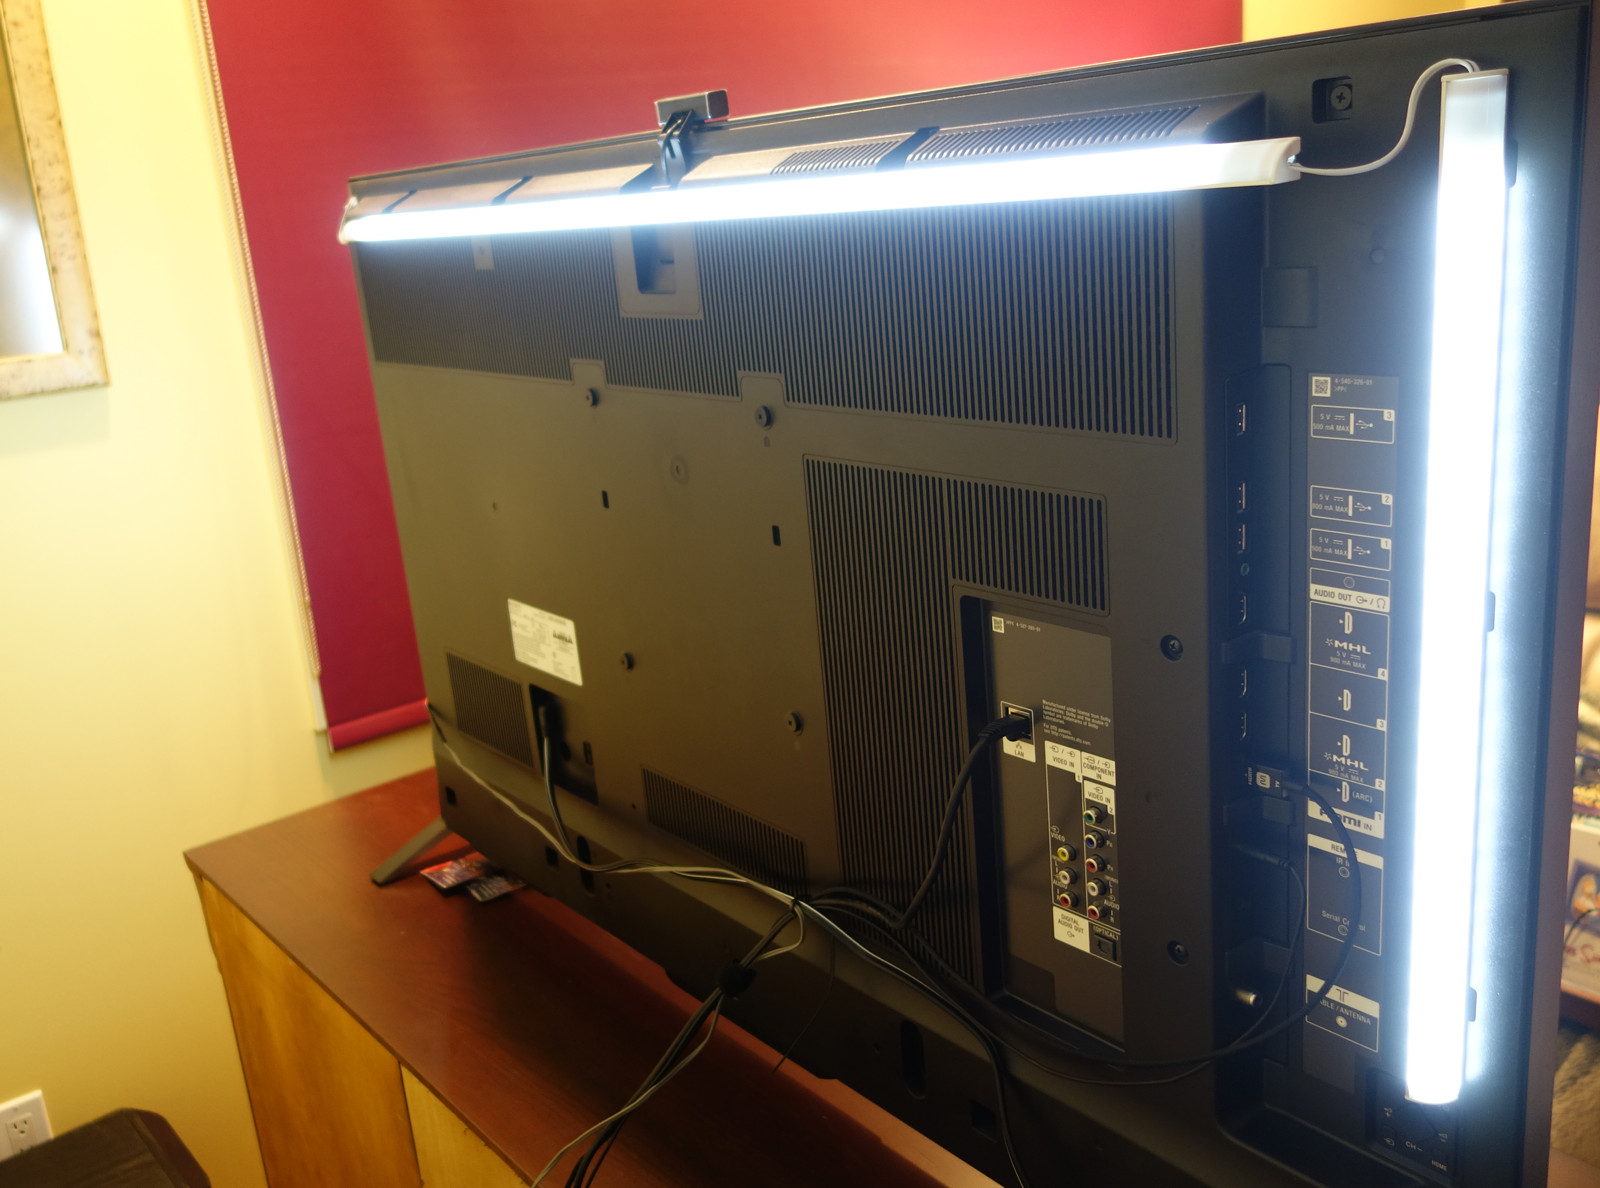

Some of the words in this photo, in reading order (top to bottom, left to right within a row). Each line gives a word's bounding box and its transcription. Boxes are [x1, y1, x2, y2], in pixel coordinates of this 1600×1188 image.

[1386, 411, 1392, 419] 3
[1335, 424, 1350, 432] MAX
[1384, 495, 1390, 503] 2
[1335, 505, 1348, 513] MAX
[1334, 548, 1348, 556] MAX
[1313, 588, 1335, 598] AUDIO
[1337, 592, 1352, 601] OUT
[1334, 639, 1372, 655] MHL
[1352, 661, 1367, 669] MAX
[1379, 720, 1384, 728] 3
[1014, 749, 1025, 758] LAN
[1052, 755, 1068, 766] VIDEO
[1332, 754, 1369, 771] MHL
[1082, 762, 1115, 777] COMPONENT
[1350, 774, 1364, 783] MAX
[1377, 780, 1383, 788] 2
[1087, 791, 1104, 802] VIDEO
[1352, 791, 1373, 803] (ARC)
[1363, 823, 1372, 831] IN
[1050, 831, 1066, 842] VIDEO
[1335, 857, 1343, 865] IR
[1103, 899, 1120, 911] AUDIO
[1060, 913, 1080, 926] DIGITAL
[1321, 910, 1341, 923] Serial
[1057, 919, 1073, 930] AUDIO
[1074, 925, 1084, 934] OUT
[1339, 1006, 1371, 1025] ANTENNA
